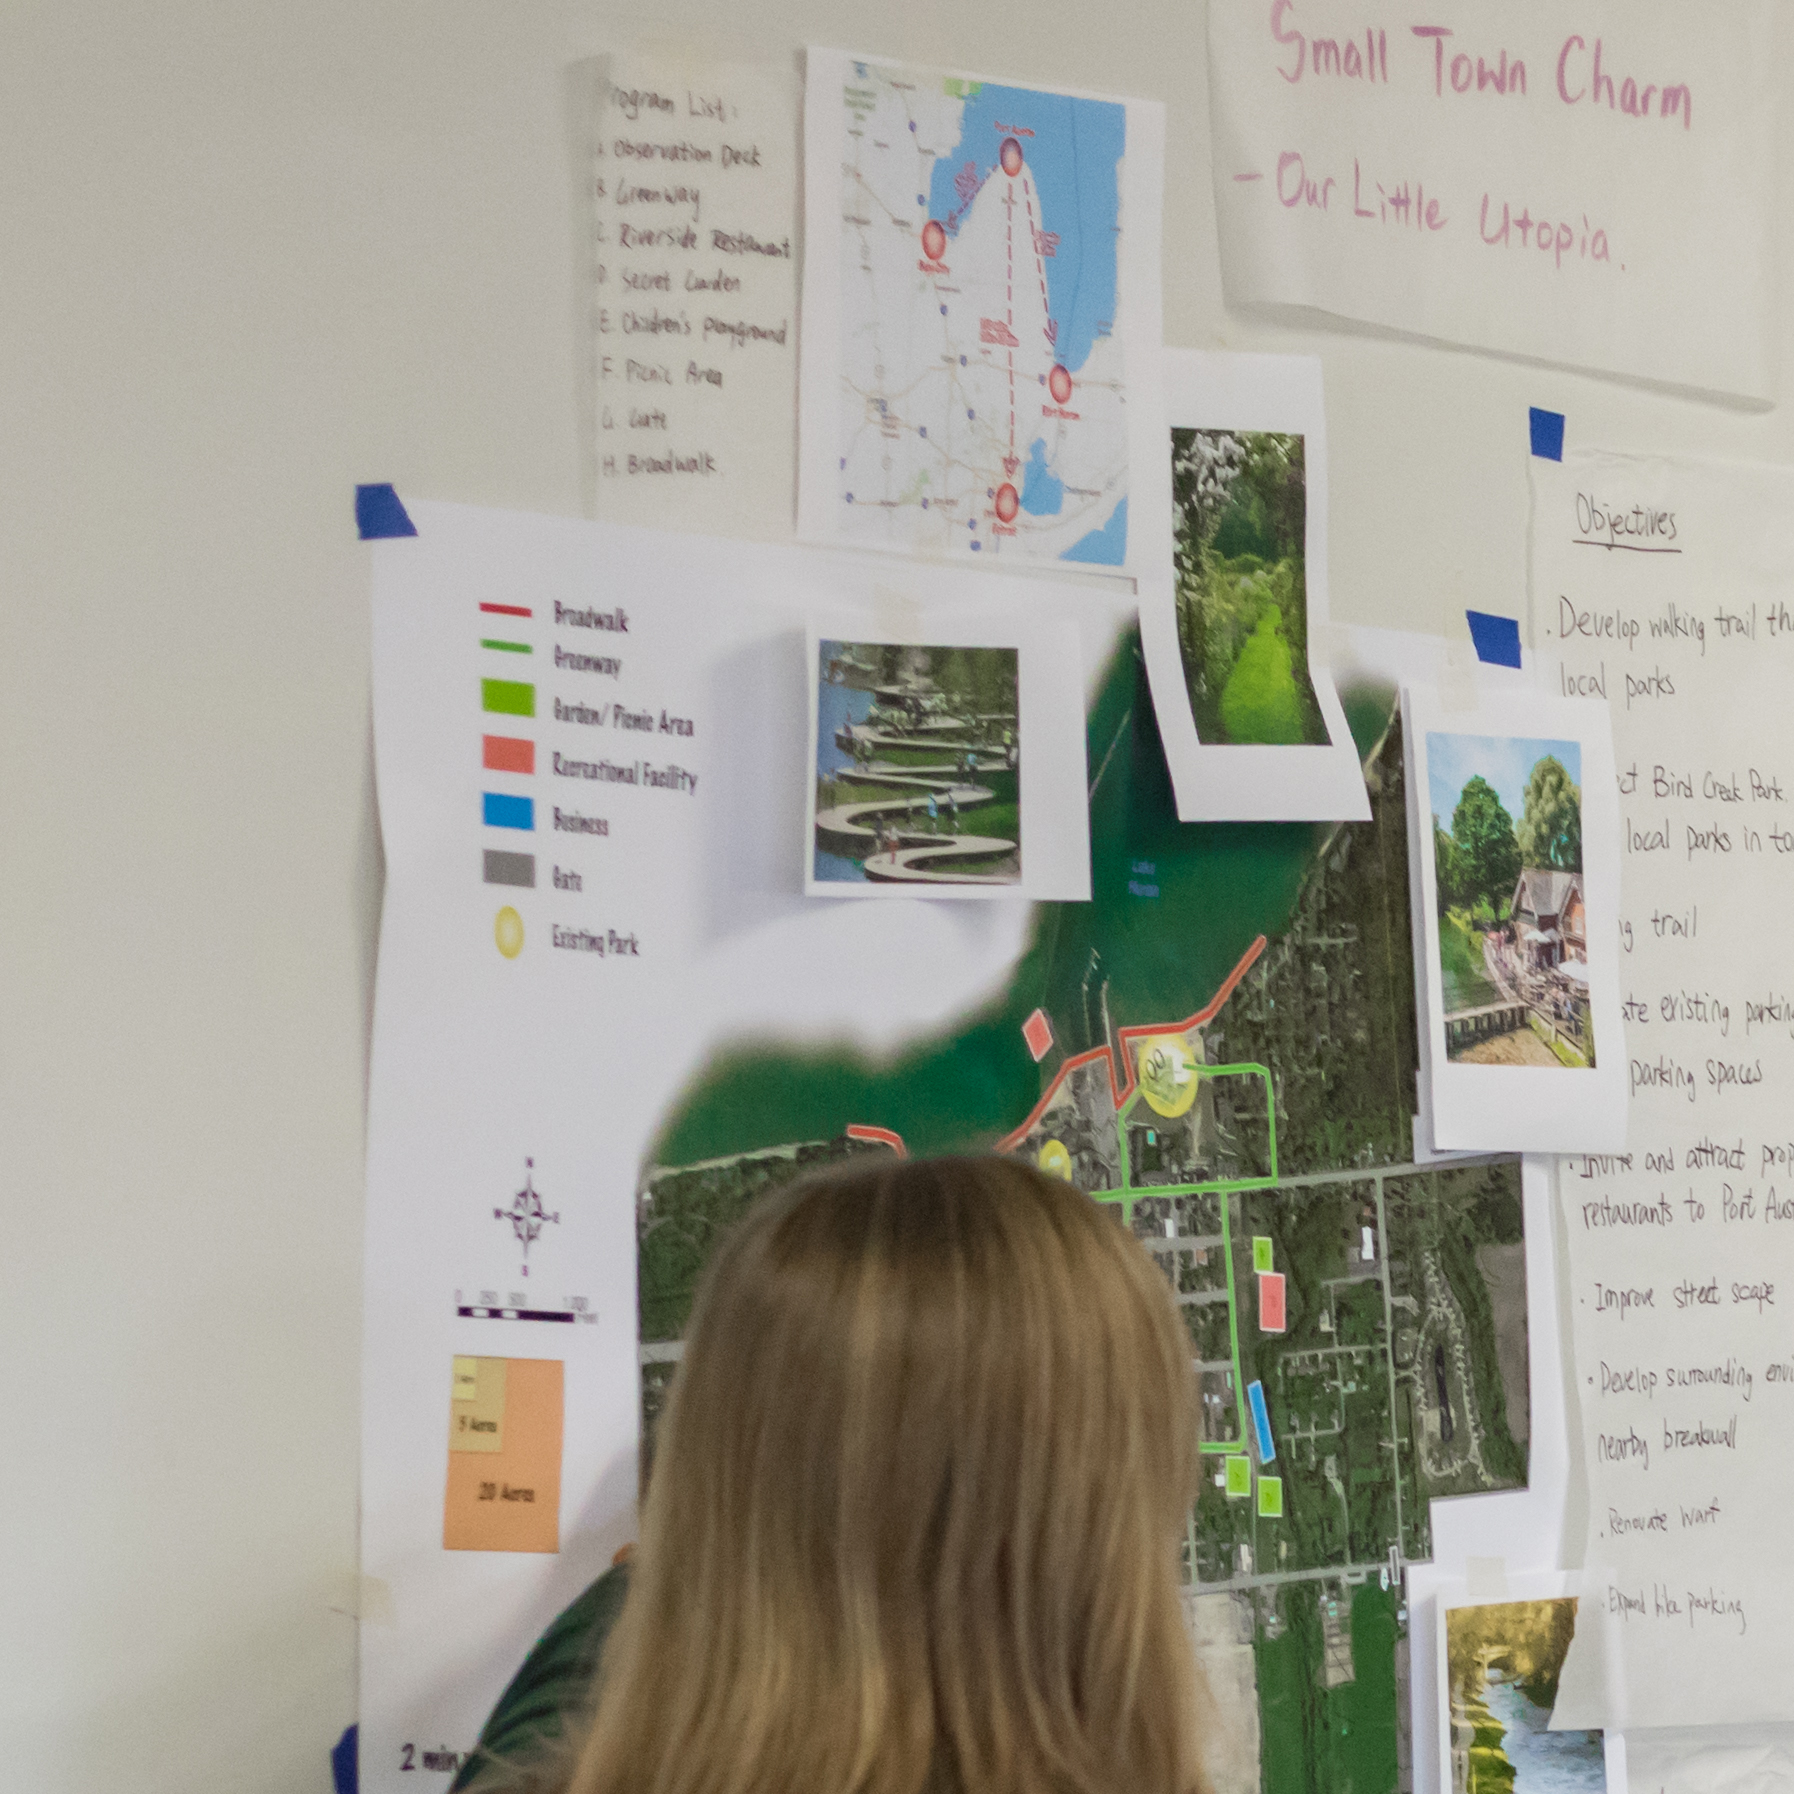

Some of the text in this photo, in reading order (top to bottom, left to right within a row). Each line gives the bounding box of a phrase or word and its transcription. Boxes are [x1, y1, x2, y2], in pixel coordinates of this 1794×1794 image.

[1270, 0, 1693, 131] Small Town Charm
[1275, 150, 1626, 273] Our Little Utopia.
[1577, 492, 1678, 550] Objectives
[553, 599, 629, 633] Broadwalk
[1560, 595, 1640, 651] Develop
[1649, 602, 1706, 656] walking
[1714, 602, 1758, 640] trail
[553, 643, 622, 681] Greenway
[1560, 661, 1676, 711] local parks
[613, 703, 654, 733] Picnic
[658, 708, 695, 738] Area
[552, 751, 698, 797] Recreational Facility
[1653, 765, 1694, 799] Bird
[1703, 771, 1744, 804] Creek
[552, 805, 609, 837] Business
[1626, 817, 1670, 855] local
[1686, 822, 1733, 862] parks
[1743, 826, 1762, 853] in
[552, 865, 582, 893] Gate
[552, 923, 640, 959] Existing Park
[1650, 905, 1698, 939] trail
[1660, 990, 1731, 1037] existing
[1630, 1056, 1764, 1103] parking spaces
[1645, 1146, 1676, 1174] and
[1685, 1135, 1748, 1174] attract
[1582, 1192, 1675, 1231] restaurants
[1684, 1187, 1706, 1221] to
[1721, 1182, 1758, 1225] Port
[1593, 1281, 1656, 1320] Improve
[1731, 1280, 1776, 1315] scape
[1600, 1358, 1659, 1399] Develop
[1666, 1357, 1754, 1402] surrounding
[1598, 1424, 1650, 1471] nearby
[1607, 1506, 1669, 1538] Renovate
[1607, 1583, 1647, 1622] Expand
[1687, 1585, 1748, 1636] parking
[400, 1743, 416, 1772] 2
